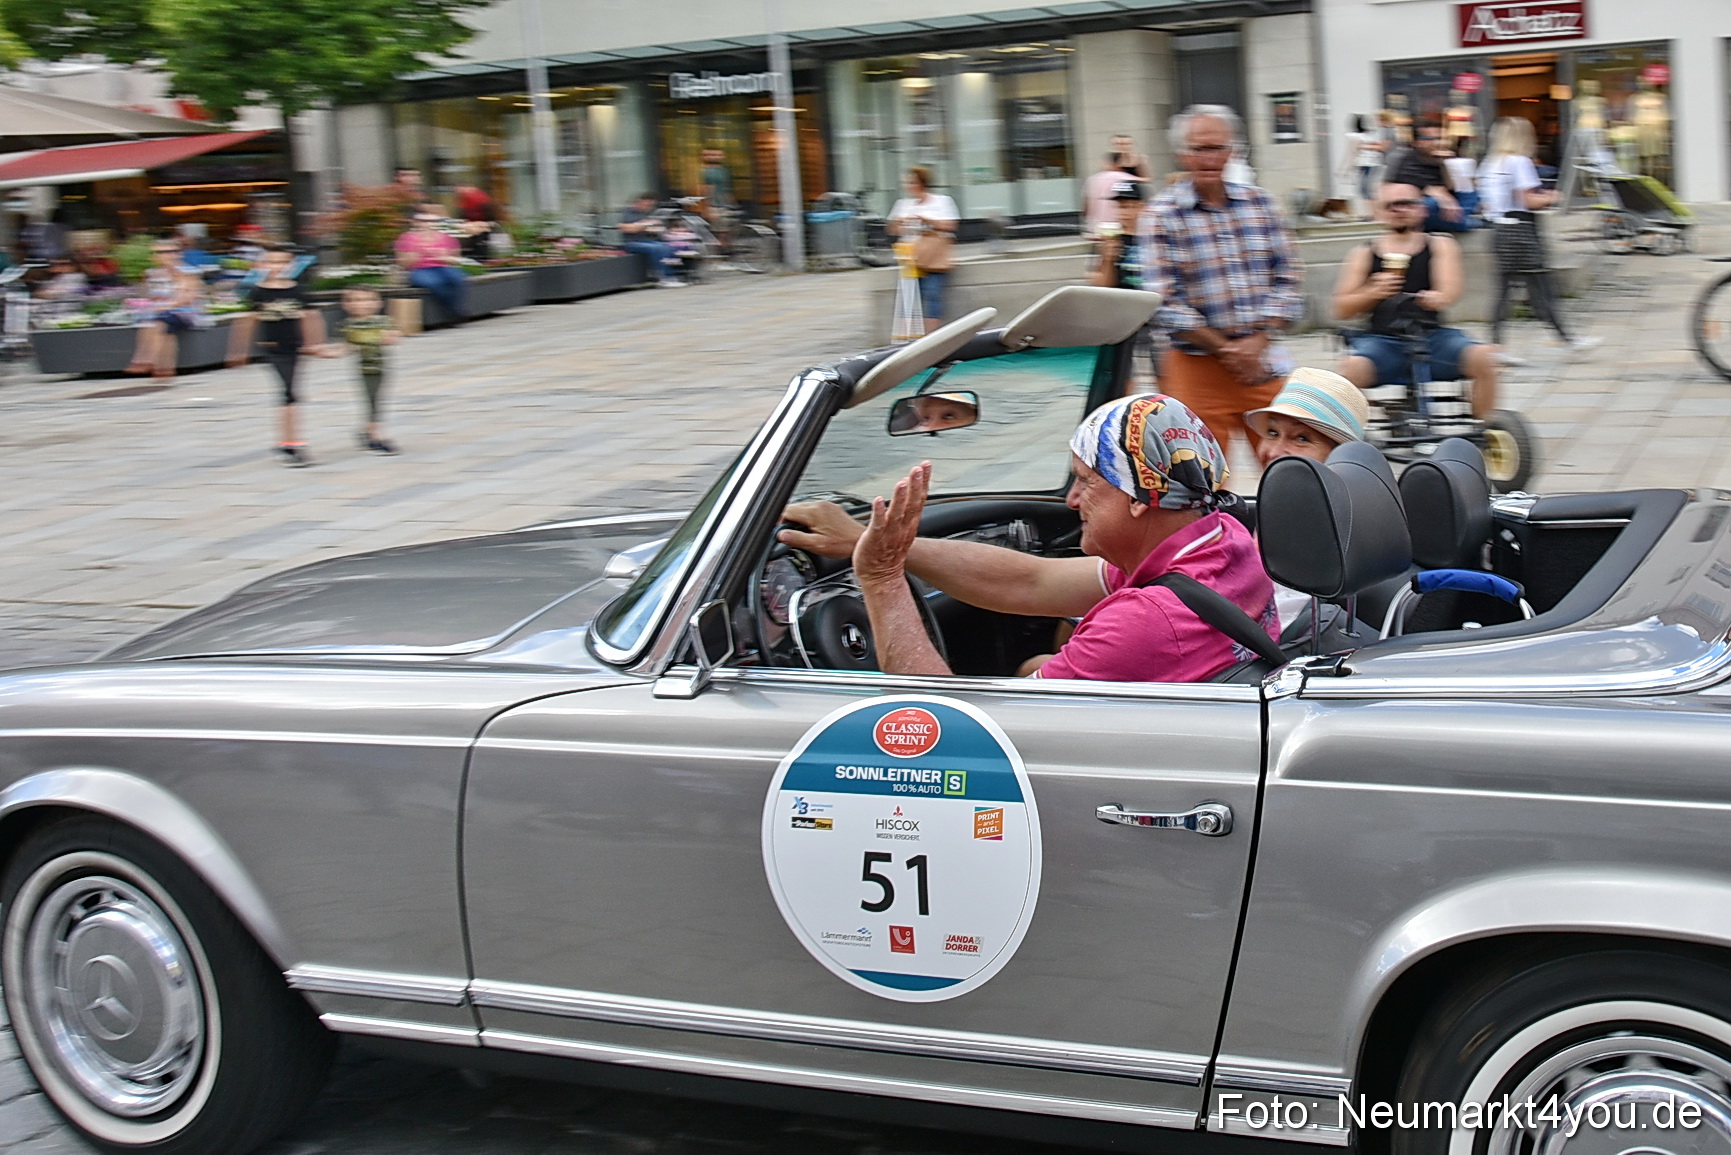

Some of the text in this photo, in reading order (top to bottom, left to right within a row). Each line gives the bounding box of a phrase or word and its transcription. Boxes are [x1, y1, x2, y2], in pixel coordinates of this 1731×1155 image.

[882, 722, 933, 735] CLASSIC
[884, 734, 928, 746] SPRINT
[835, 765, 961, 790] SONNLEITNER S
[892, 783, 942, 794] 100 % AUTO
[977, 811, 1000, 822] PRINT
[876, 818, 921, 832] HISCOX
[977, 825, 1000, 836] PIXEL
[860, 851, 930, 916] 51
[945, 934, 974, 945] JANDA
[945, 942, 979, 953] DORRER
